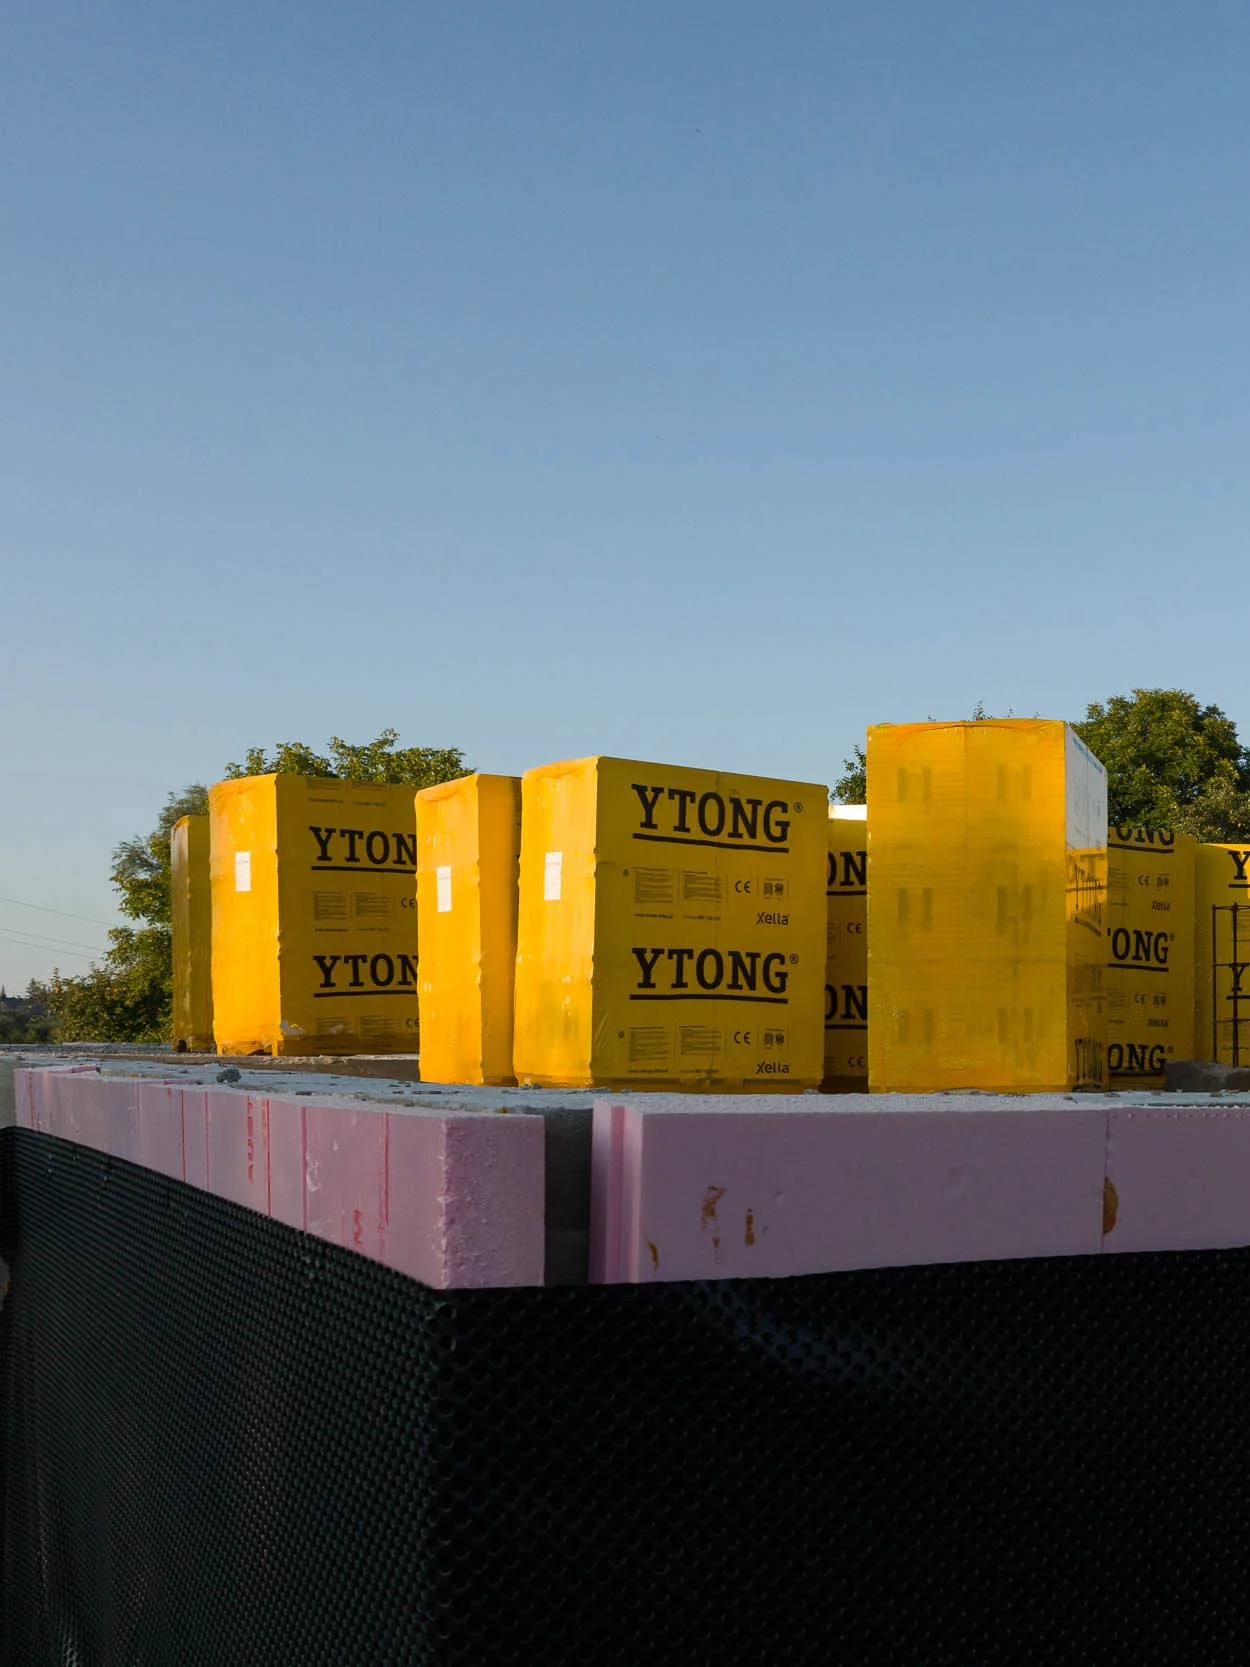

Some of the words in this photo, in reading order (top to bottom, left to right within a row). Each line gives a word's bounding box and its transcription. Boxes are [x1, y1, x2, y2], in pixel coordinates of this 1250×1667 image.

[308, 825, 417, 866] YTON
[756, 912, 789, 926] Xella
[313, 952, 418, 988] YTON
[756, 1061, 790, 1075] Xella
